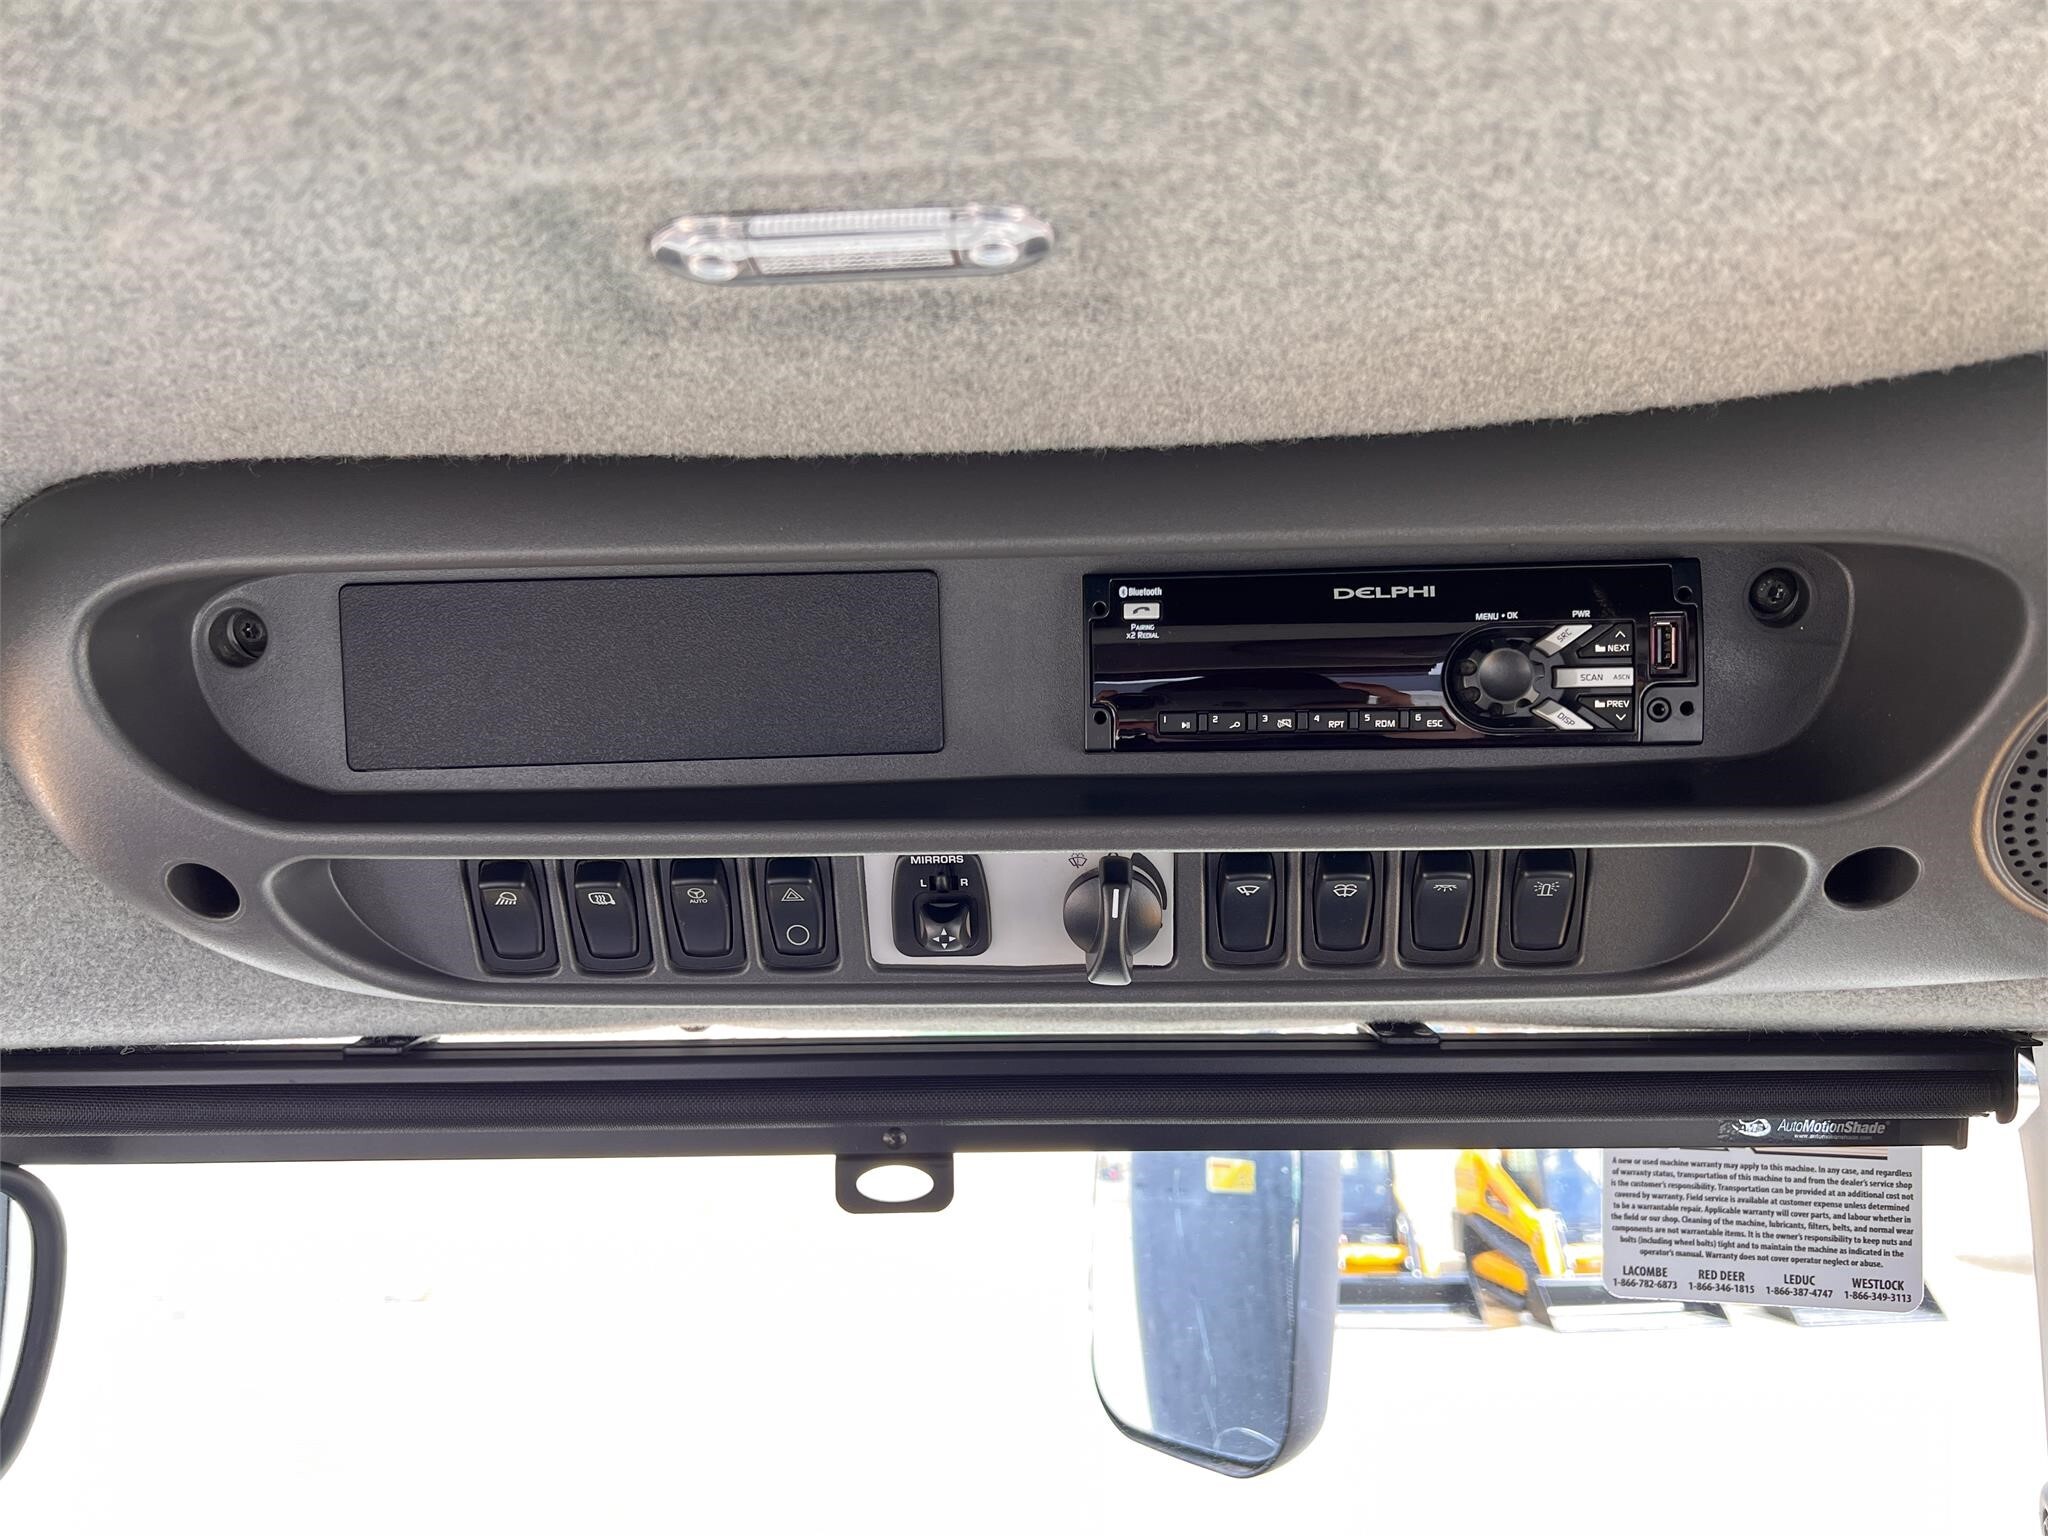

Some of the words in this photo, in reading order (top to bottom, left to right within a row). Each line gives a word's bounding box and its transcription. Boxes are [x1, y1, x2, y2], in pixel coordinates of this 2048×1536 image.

[1129, 587, 1162, 597] Bluetooth
[1334, 586, 1436, 599] DELPHI
[1475, 612, 1499, 621] MENU
[1507, 611, 1518, 620] OK
[1572, 610, 1591, 618] PWR
[1126, 632, 1136, 640] x2
[1556, 628, 1573, 643] SRC
[1607, 644, 1630, 652] NEXT
[1580, 673, 1604, 682] SCAN
[1606, 700, 1630, 709] PREV
[1212, 715, 1218, 723] 2
[1262, 714, 1268, 722] 3
[1313, 714, 1320, 722] 4
[1328, 720, 1345, 729] RPT
[1364, 714, 1370, 722] 5
[1375, 719, 1396, 728] RDM
[1426, 719, 1443, 727] ESC
[1556, 712, 1575, 727] DISP
[910, 855, 964, 865] MIRRORS
[920, 879, 927, 888] L
[960, 878, 969, 887] R
[1777, 1118, 1886, 1134] AutoMotionShade
[1612, 1156, 1617, 1164] A
[1642, 1157, 1658, 1166] used
[1660, 1158, 1689, 1168] machine
[1691, 1159, 1722, 1171] warranty
[1724, 1163, 1738, 1171] may
[1740, 1162, 1759, 1172] apply
[1761, 1162, 1768, 1171] to
[1770, 1163, 1783, 1172] this
[1819, 1165, 1825, 1173] In
[1827, 1167, 1840, 1176] any
[1861, 1167, 1874, 1176] and
[1876, 1167, 1912, 1179] regardless
[1621, 1167, 1651, 1179] warranty
[1677, 1170, 1728, 1182] transportation
[1729, 1172, 1737, 1181] of
[1738, 1173, 1751, 1181] this
[1753, 1173, 1783, 1183] machine
[1784, 1175, 1792, 1183] to
[1793, 1175, 1807, 1184] and
[1808, 1176, 1825, 1185] from
[1827, 1177, 1839, 1185] the
[1870, 1179, 1894, 1188] service
[1896, 1180, 1912, 1190] shop
[1618, 1179, 1629, 1188] the
[1718, 1183, 1770, 1196] Transportation
[1785, 1186, 1794, 1195] be
[1795, 1187, 1826, 1198] provided
[1828, 1188, 1835, 1196] at
[1848, 1189, 1884, 1198] additional
[1886, 1190, 1900, 1199] cost
[1902, 1191, 1914, 1200] not
[1615, 1190, 1641, 1199] covered
[1642, 1191, 1650, 1202] by
[1686, 1193, 1703, 1202] Field
[1705, 1194, 1728, 1203] service
[1737, 1195, 1769, 1205] available
[1770, 1197, 1777, 1205] at
[1779, 1197, 1812, 1207] customer
[1814, 1201, 1842, 1210] expense
[1844, 1200, 1867, 1209] unless
[1868, 1201, 1909, 1211] determined
[1622, 1201, 1630, 1210] be
[1637, 1202, 1679, 1212] warrantable
[1705, 1205, 1741, 1217] Applicable
[1743, 1207, 1774, 1219] warranty
[1776, 1209, 1789, 1218] will
[1791, 1211, 1809, 1219] cover
[1833, 1212, 1846, 1220] and
[1848, 1212, 1871, 1222] labour
[1872, 1214, 1903, 1223] whether
[1905, 1215, 1911, 1224] in
[1611, 1212, 1622, 1221] the
[1624, 1213, 1639, 1222] field
[1682, 1215, 1712, 1227] Cleaning
[1713, 1217, 1720, 1226] of
[1722, 1217, 1734, 1226] the
[1854, 1224, 1867, 1233] and
[1869, 1225, 1894, 1234] normal
[1612, 1223, 1653, 1235] components
[1667, 1226, 1679, 1235] not
[1681, 1226, 1723, 1237] warrantable
[1762, 1230, 1774, 1239] the
[1805, 1233, 1852, 1245] responsibility
[1854, 1235, 1861, 1244] to
[1863, 1235, 1880, 1246] keep
[1882, 1236, 1897, 1245] nuts
[1899, 1237, 1912, 1246] and
[1620, 1235, 1636, 1244] bolts
[1638, 1236, 1672, 1248] (including
[1674, 1238, 1695, 1247] wheel
[1697, 1239, 1716, 1250] bolts)
[1718, 1240, 1735, 1251] tight
[1737, 1241, 1750, 1250] and
[1752, 1242, 1759, 1250] to
[1761, 1242, 1793, 1252] maintain
[1794, 1244, 1806, 1253] the
[1808, 1245, 1838, 1254] machine
[1849, 1247, 1882, 1257] indicated
[1892, 1249, 1904, 1258] the
[1706, 1250, 1738, 1262] Warranty
[1739, 1252, 1755, 1261] does
[1757, 1253, 1769, 1262] not
[1791, 1255, 1821, 1267] operator
[1823, 1257, 1849, 1268] neglect
[1623, 1265, 1668, 1278] LACOMBE
[1698, 1269, 1717, 1280] RED
[1720, 1270, 1745, 1282] DEER
[1613, 1278, 1677, 1289] 1-866-782-6873
[1783, 1274, 1815, 1286] LEDUC
[1852, 1278, 1905, 1291] WESTLOCK
[1689, 1282, 1755, 1294] 1-866-346-1815
[1766, 1286, 1833, 1298] 1-866-387-4747
[1844, 1291, 1912, 1303] 1-866-349-3113
